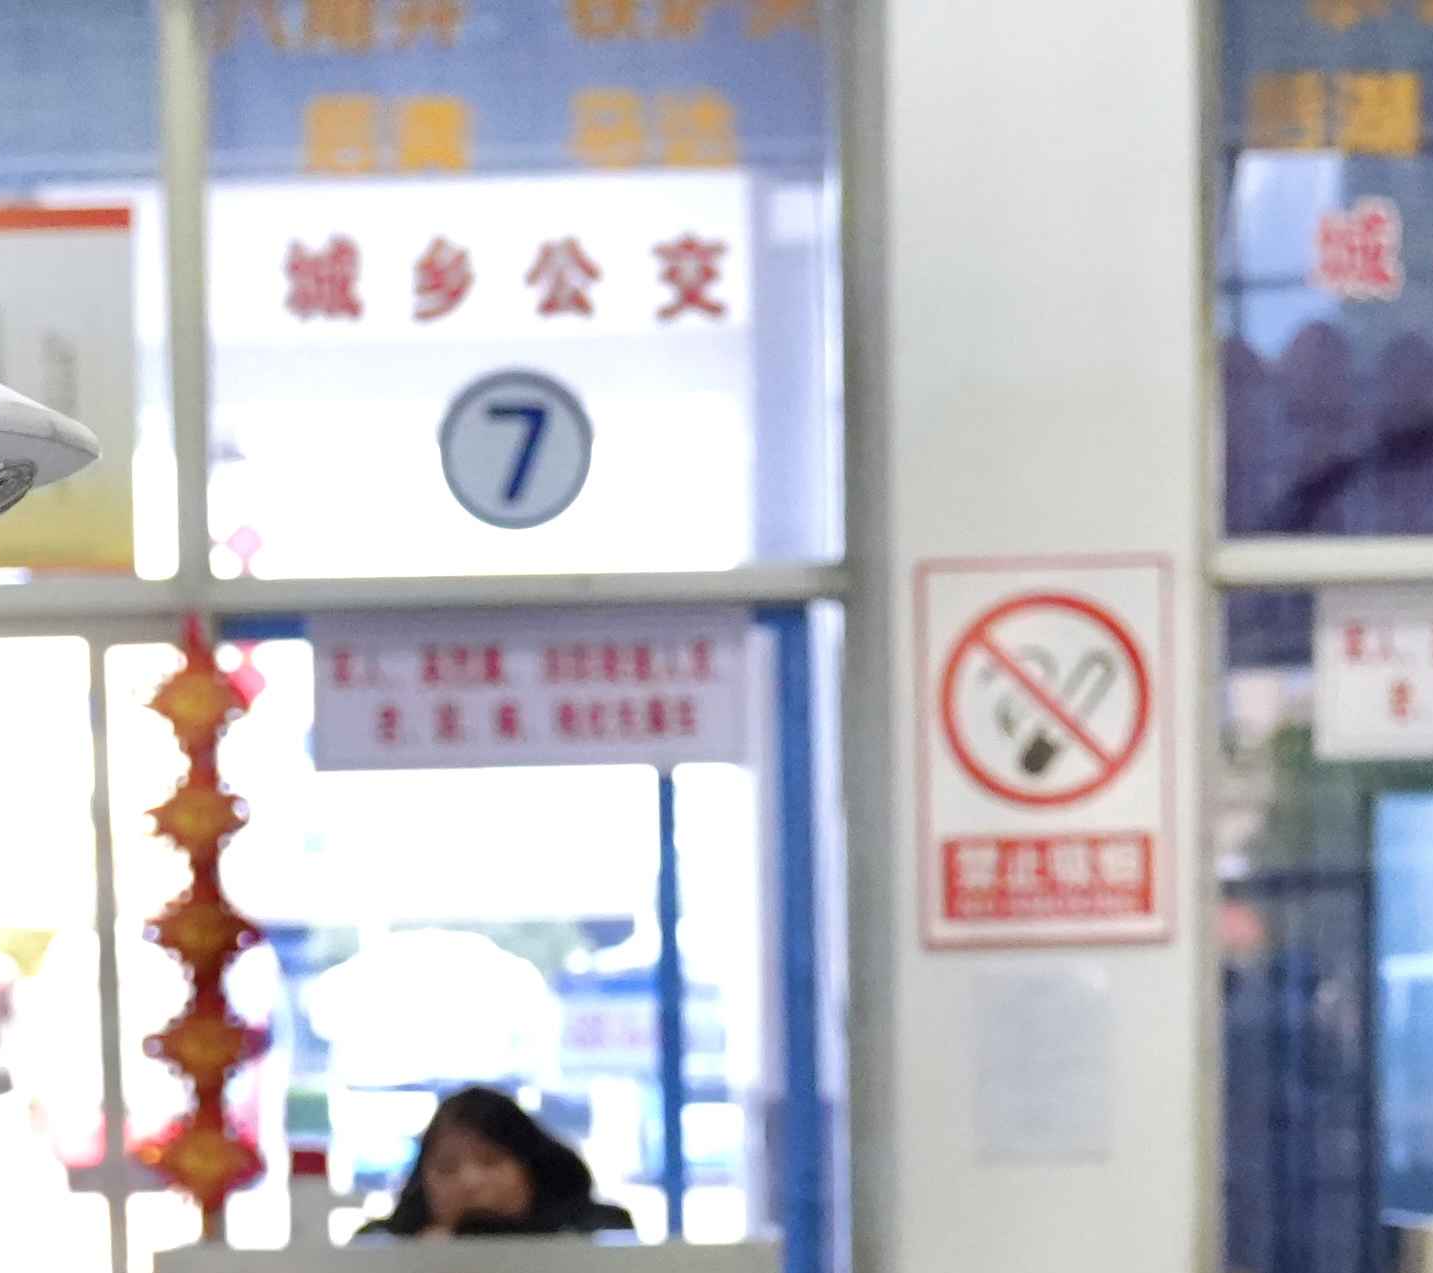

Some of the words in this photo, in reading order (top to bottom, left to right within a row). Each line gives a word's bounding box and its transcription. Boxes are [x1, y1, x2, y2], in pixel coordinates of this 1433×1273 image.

[284, 232, 729, 322] 城乡公交
[486, 405, 548, 503] 7
